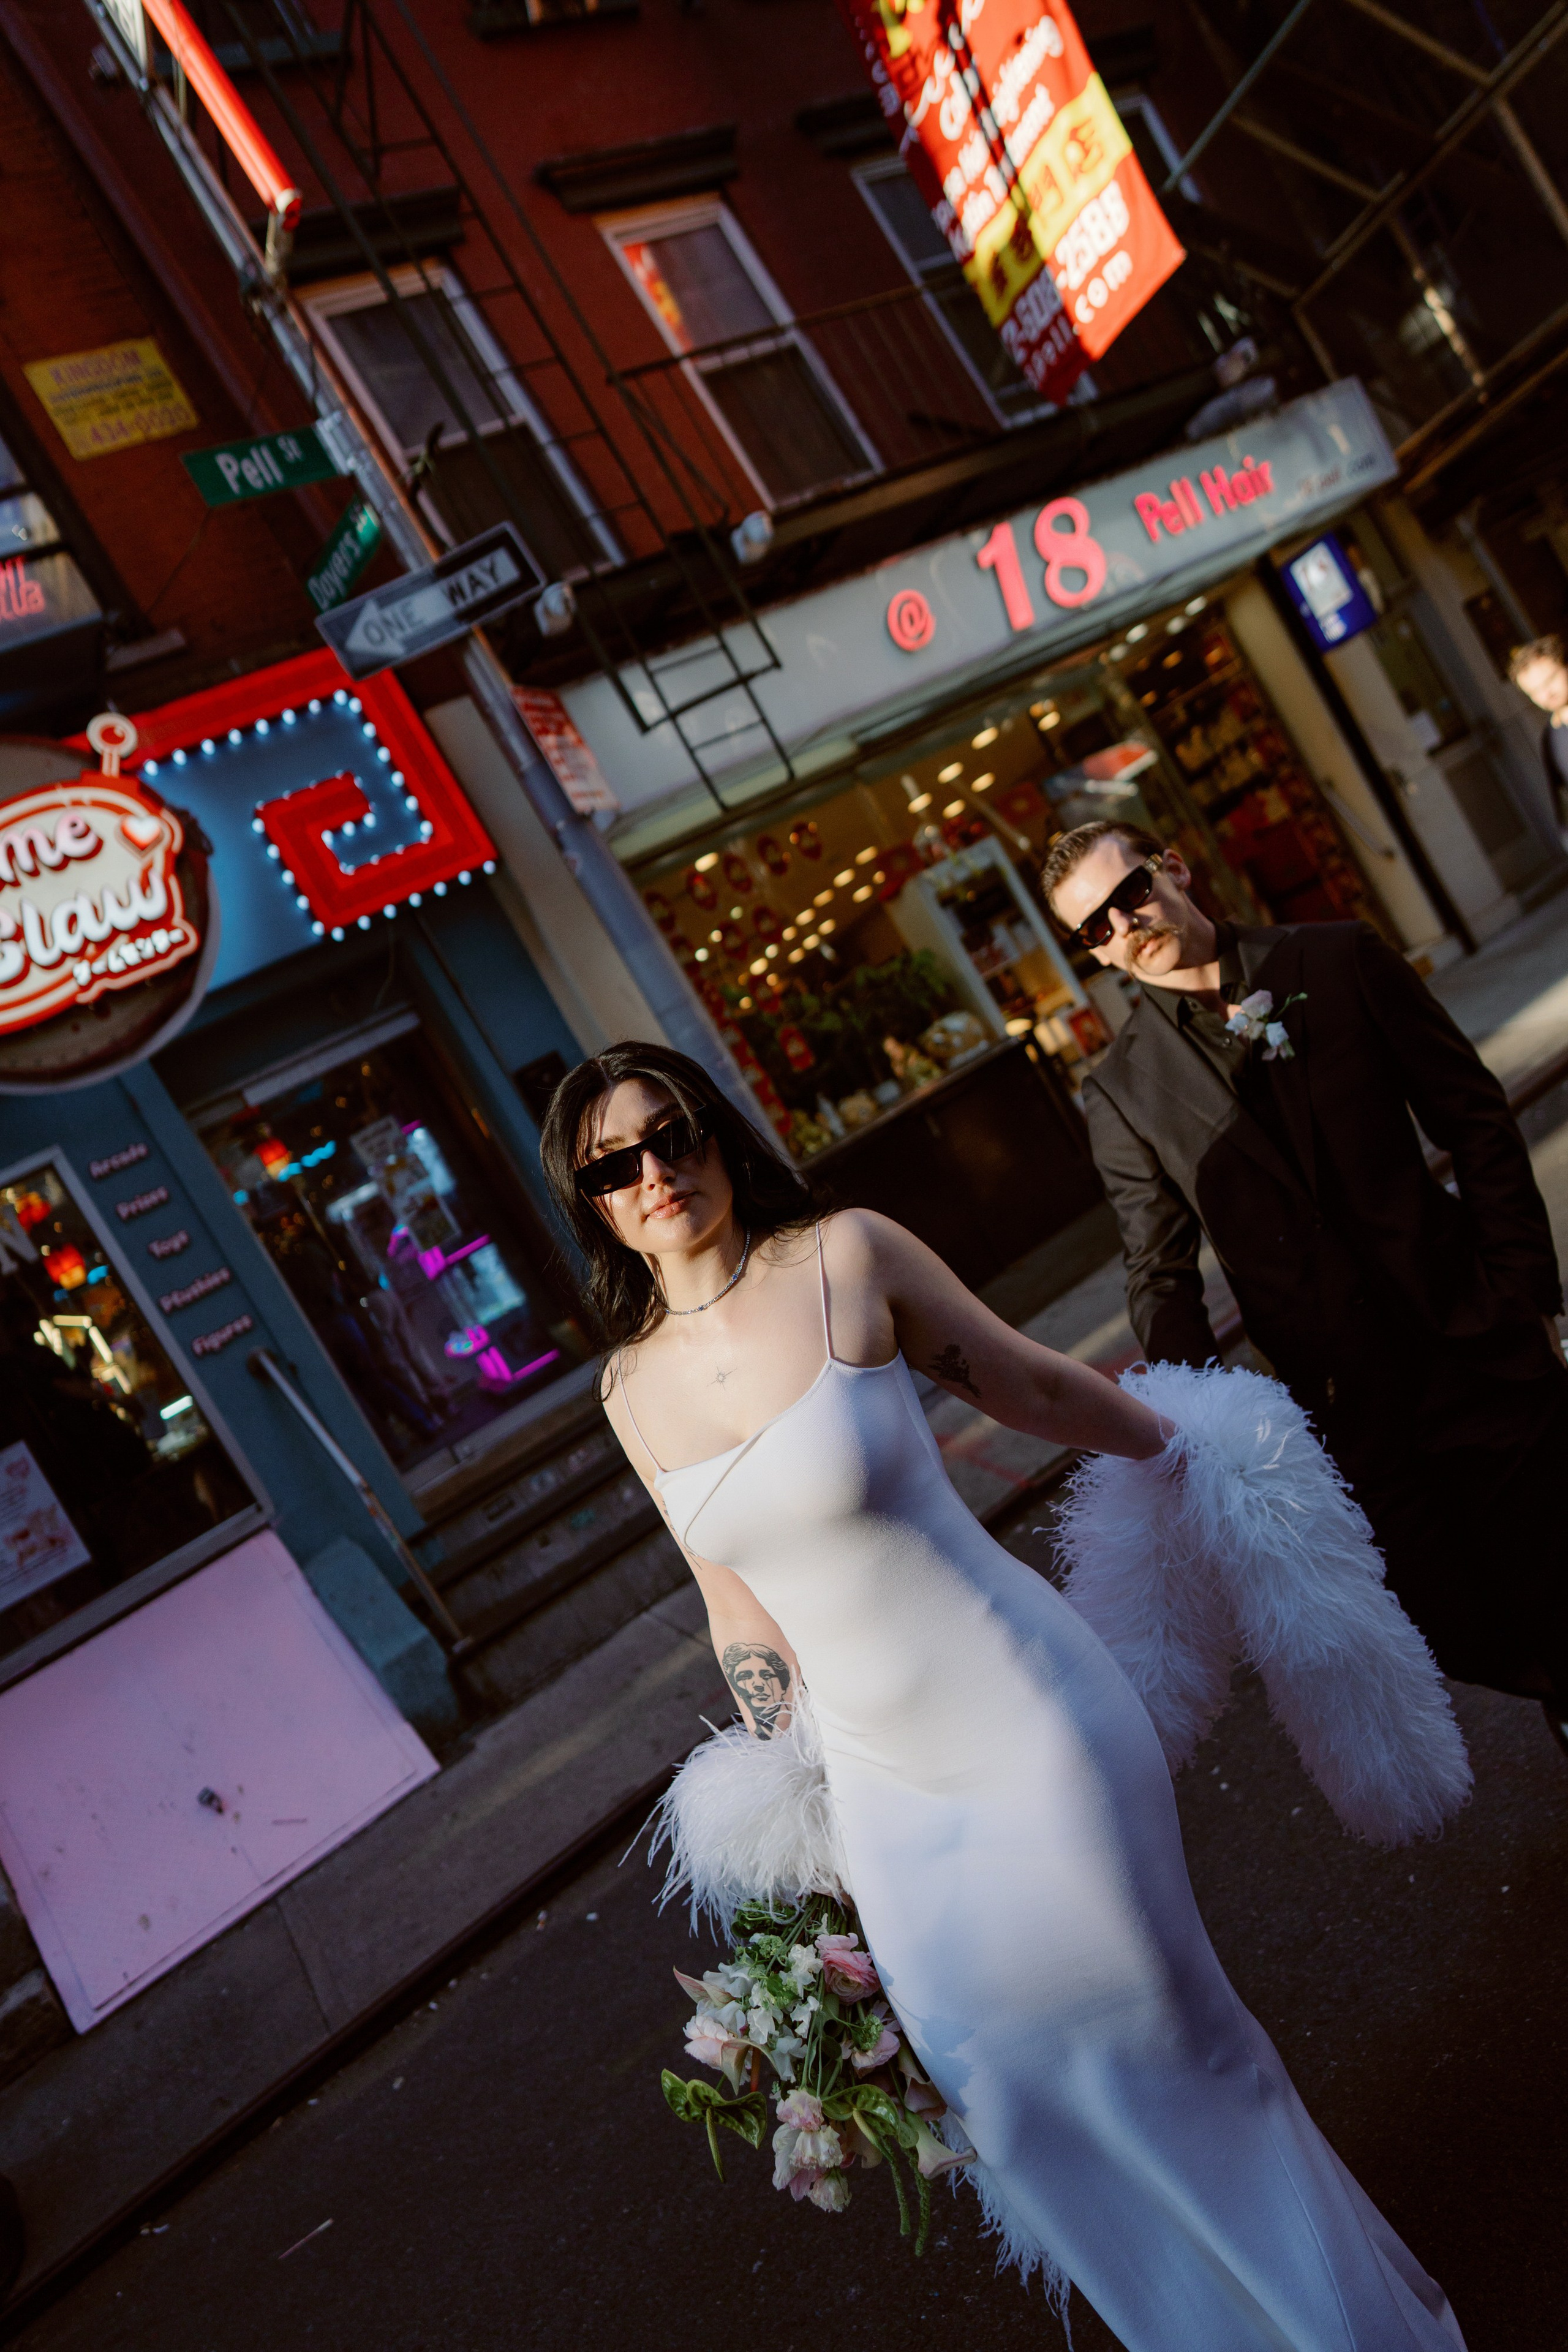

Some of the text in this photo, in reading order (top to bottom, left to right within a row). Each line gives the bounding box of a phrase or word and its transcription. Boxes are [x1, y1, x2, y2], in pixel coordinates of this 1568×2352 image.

[215, 435, 303, 495] Pell St
[308, 530, 361, 611] Doyers
[887, 589, 935, 652] @
[977, 496, 1106, 631] 18
[1134, 478, 1205, 543] Pell
[1200, 455, 1275, 516] Hair
[363, 553, 502, 646] ONE WAY
[148, 1229, 189, 1259] Toys
[159, 1266, 231, 1314] Plushies
[192, 1314, 252, 1356] Figures
